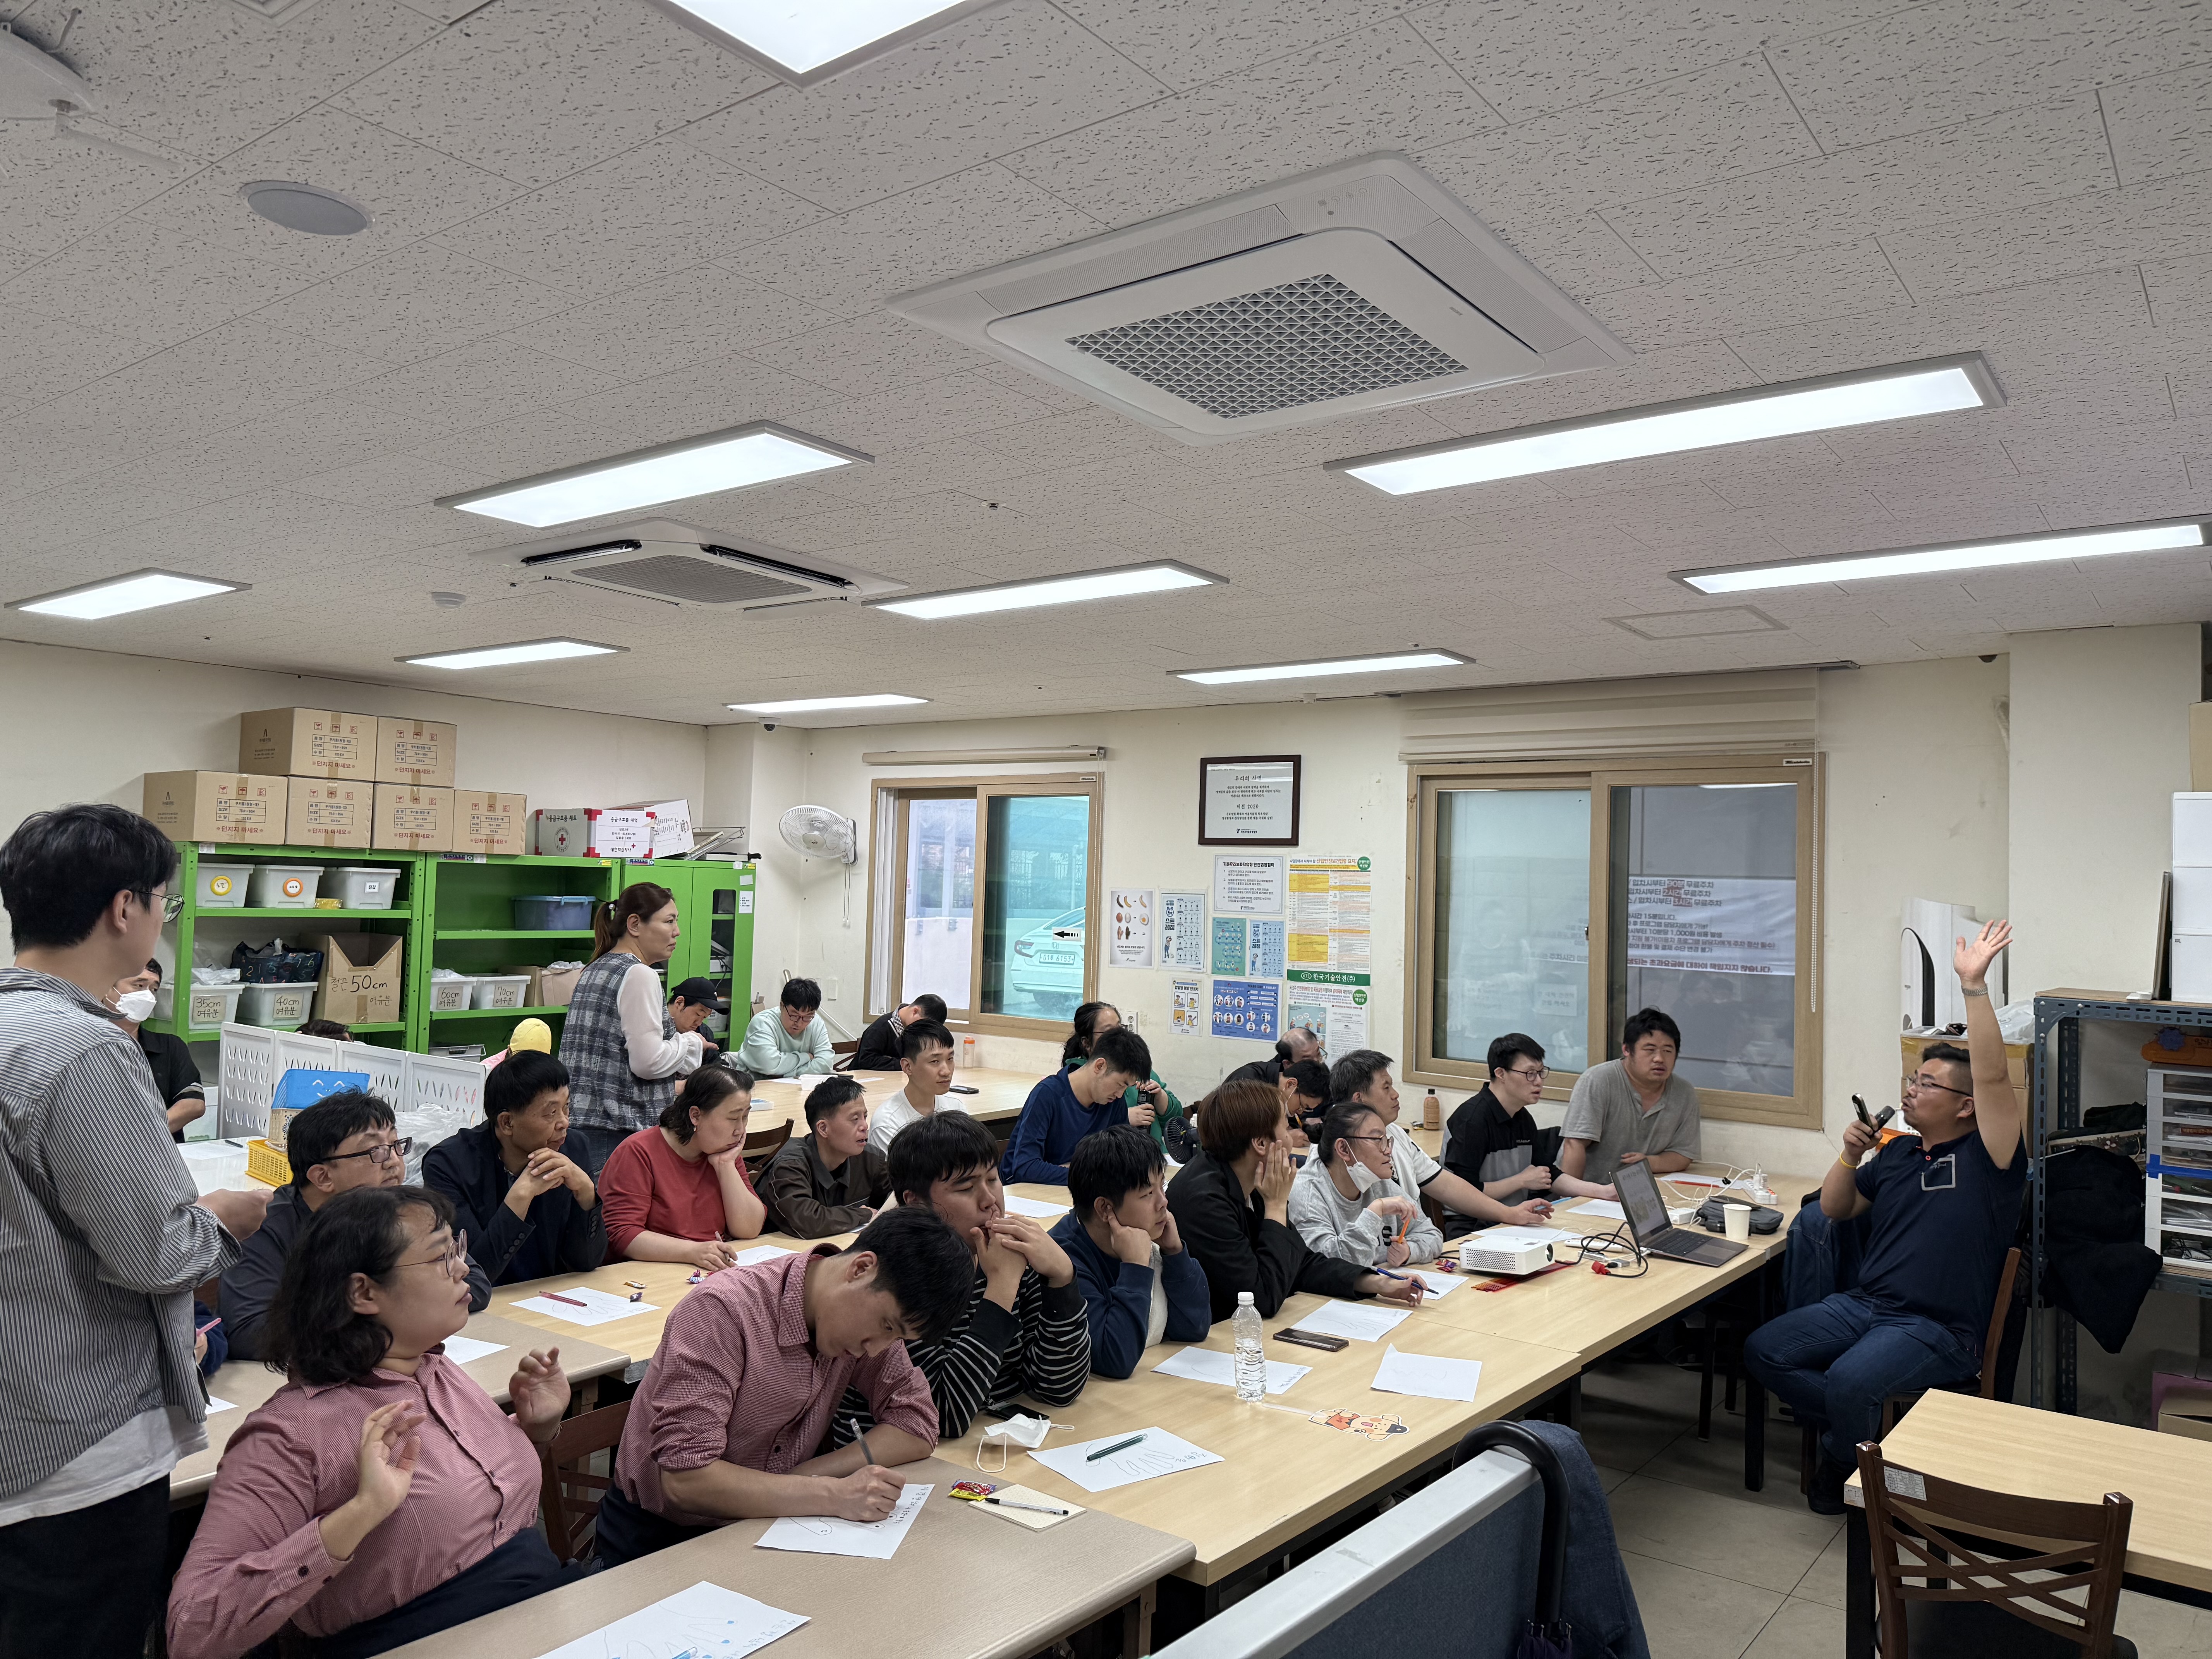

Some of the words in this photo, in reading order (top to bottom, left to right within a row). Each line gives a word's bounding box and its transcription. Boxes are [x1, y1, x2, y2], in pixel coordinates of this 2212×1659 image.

[246, 966, 253, 977] 2
[1686, 961, 1708, 969] 대하여
[1740, 965, 1772, 973] 않습니다.
[1313, 973, 1355, 982] 한국기술안전(주)
[350, 975, 387, 993] 50cm
[441, 987, 460, 999] 60cm
[497, 986, 515, 996] 70cm
[196, 998, 221, 1008] 35cm
[276, 996, 299, 1006] 40cm
[370, 995, 392, 1006] 여유분
[439, 999, 457, 1007] 여유분
[198, 1009, 219, 1018] 여유분
[276, 1007, 297, 1015] 여유분
